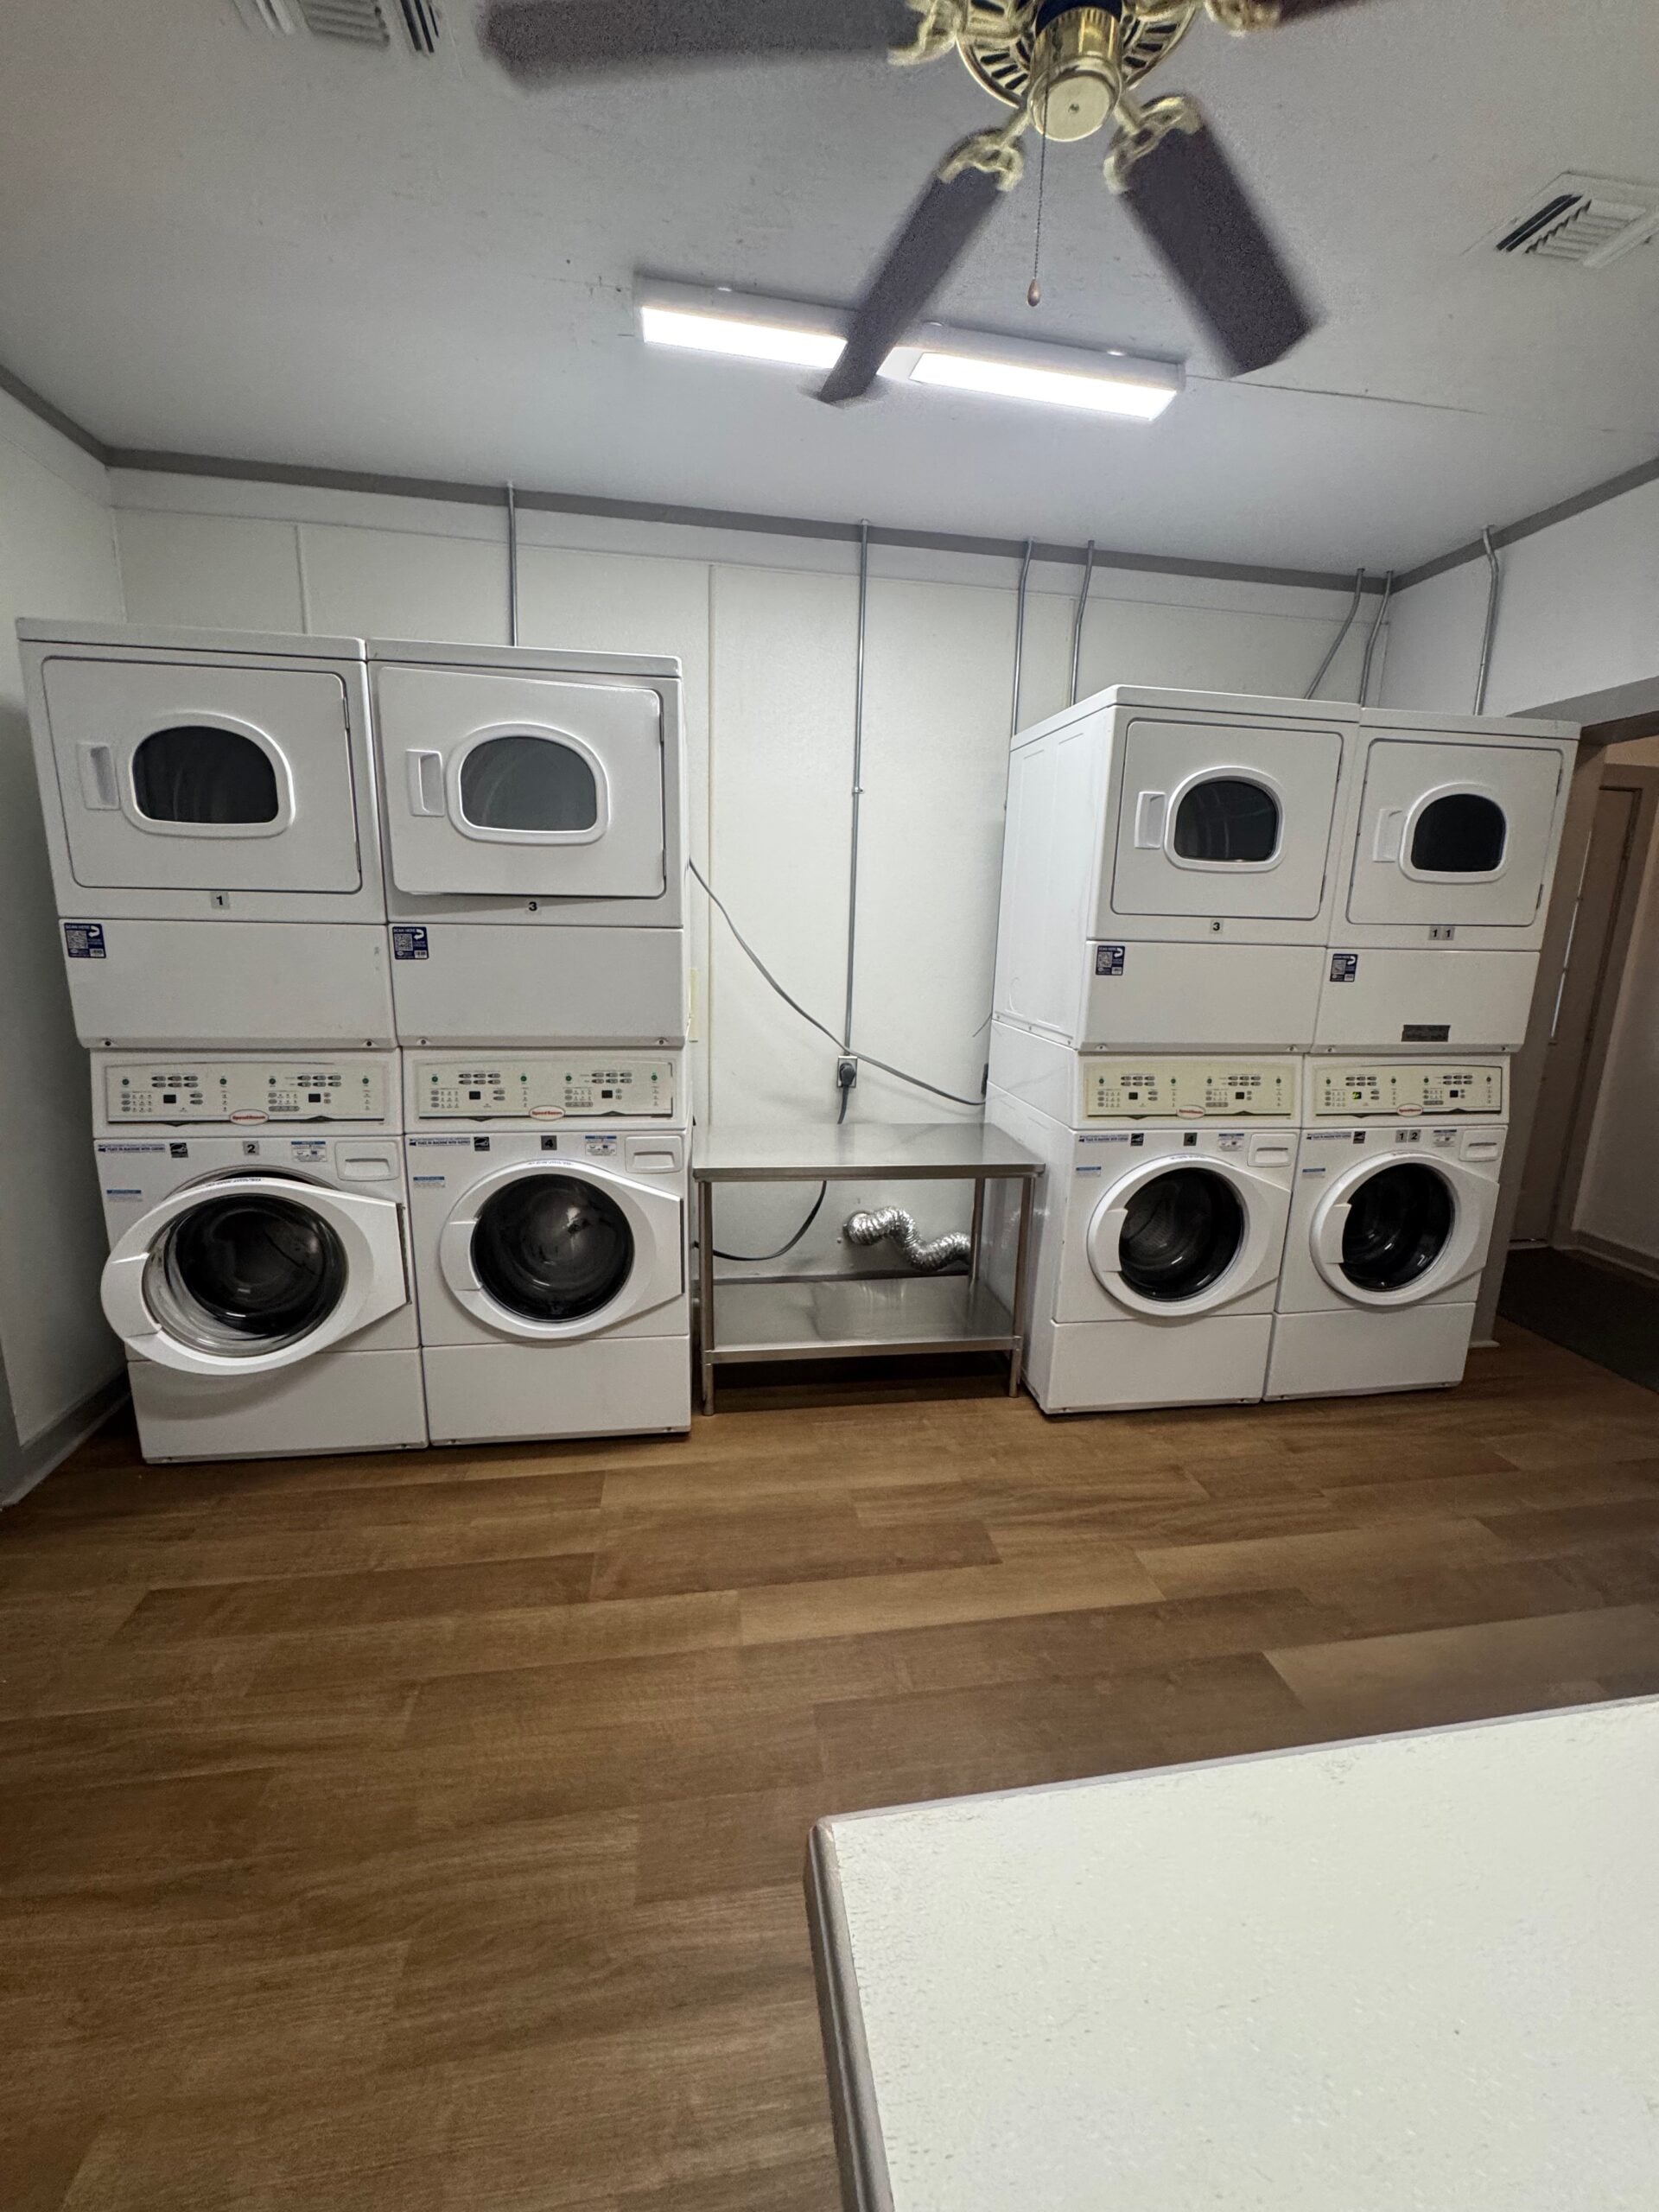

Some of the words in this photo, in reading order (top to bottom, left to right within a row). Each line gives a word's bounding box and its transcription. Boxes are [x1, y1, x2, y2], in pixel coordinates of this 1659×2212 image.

[216, 895, 223, 906] 1
[529, 901, 537, 912] 3
[1212, 921, 1220, 931] 3
[544, 1139, 554, 1148] 4
[247, 1144, 256, 1154] 2
